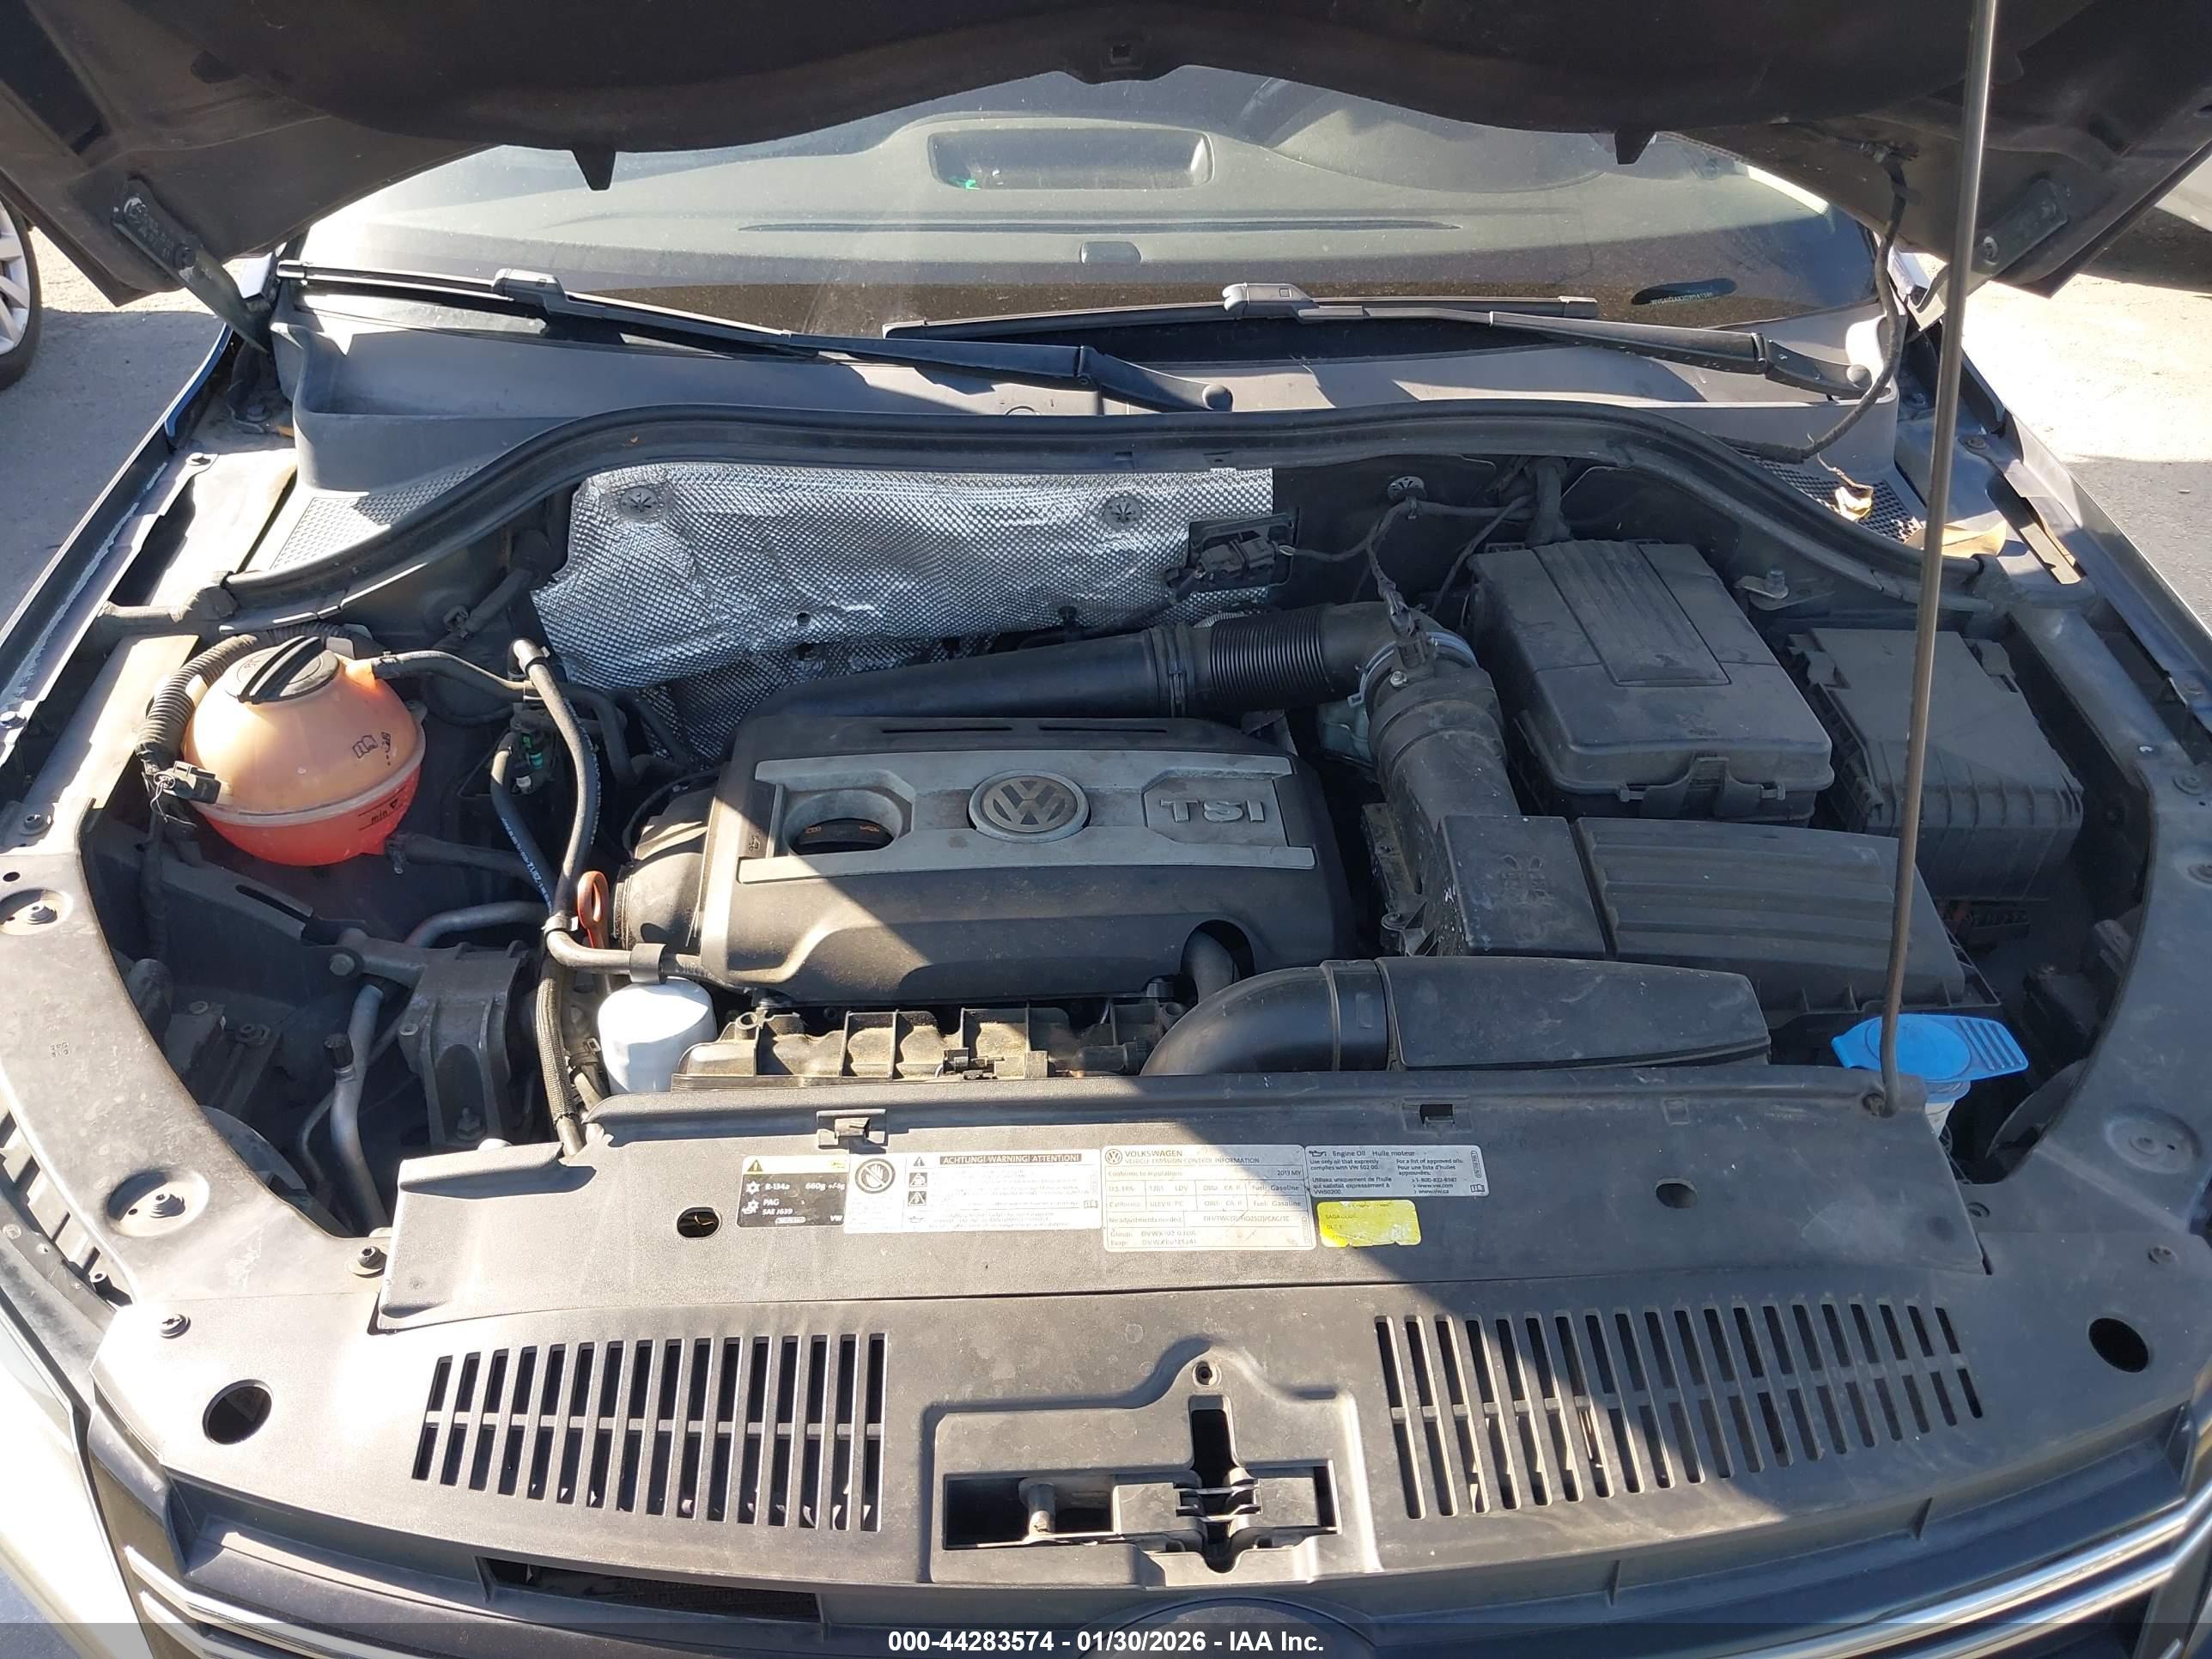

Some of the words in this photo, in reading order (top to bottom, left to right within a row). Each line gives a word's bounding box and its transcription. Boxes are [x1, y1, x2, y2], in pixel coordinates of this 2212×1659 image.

[1160, 799, 1265, 823] TSI
[371, 811, 388, 824] min
[942, 1156, 986, 1164] ACHTUNG!
[988, 1155, 1030, 1164] WARNING!
[1031, 1154, 1079, 1163] ATTENTION!
[805, 1182, 826, 1191] 660g
